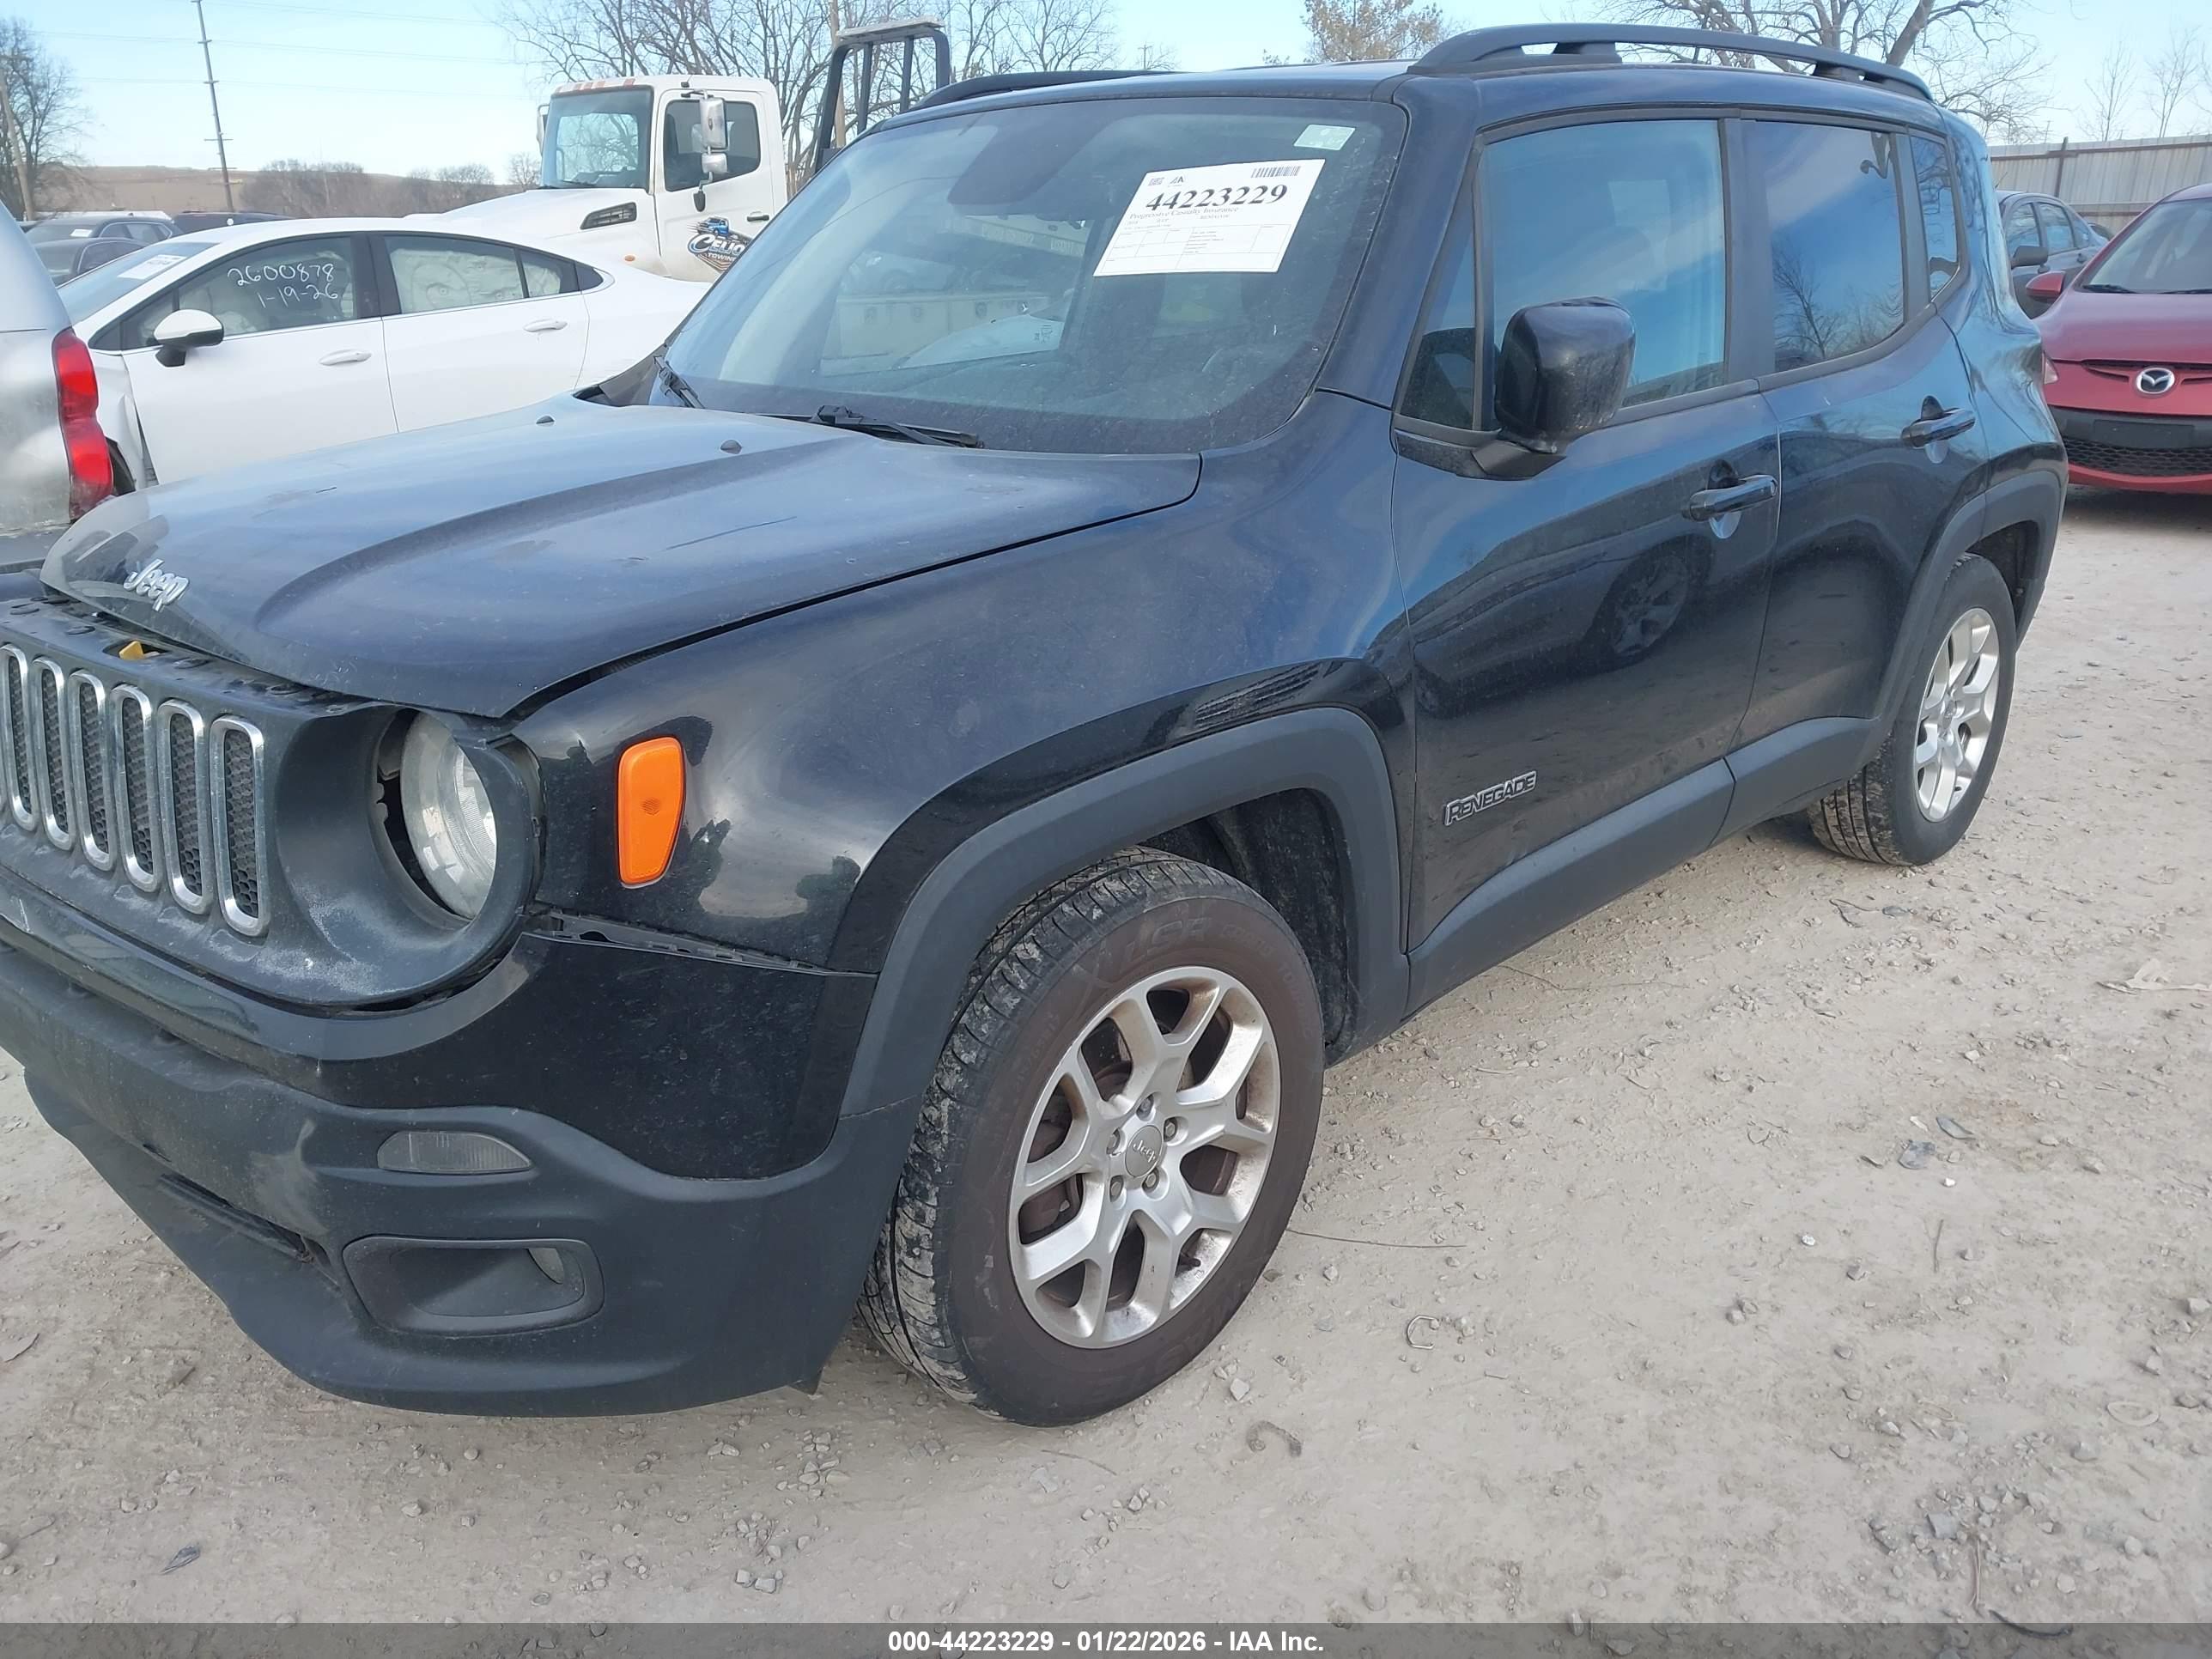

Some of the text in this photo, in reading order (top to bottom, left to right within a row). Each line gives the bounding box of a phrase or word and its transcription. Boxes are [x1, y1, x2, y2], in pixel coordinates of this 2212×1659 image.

[1146, 184, 1288, 211] 44223229
[227, 263, 334, 286] 2600878
[257, 283, 338, 308] 1-19-26
[123, 558, 189, 611] Jeep
[1443, 770, 1537, 826] RENEGADE
[1133, 1139, 1156, 1163] Jeep
